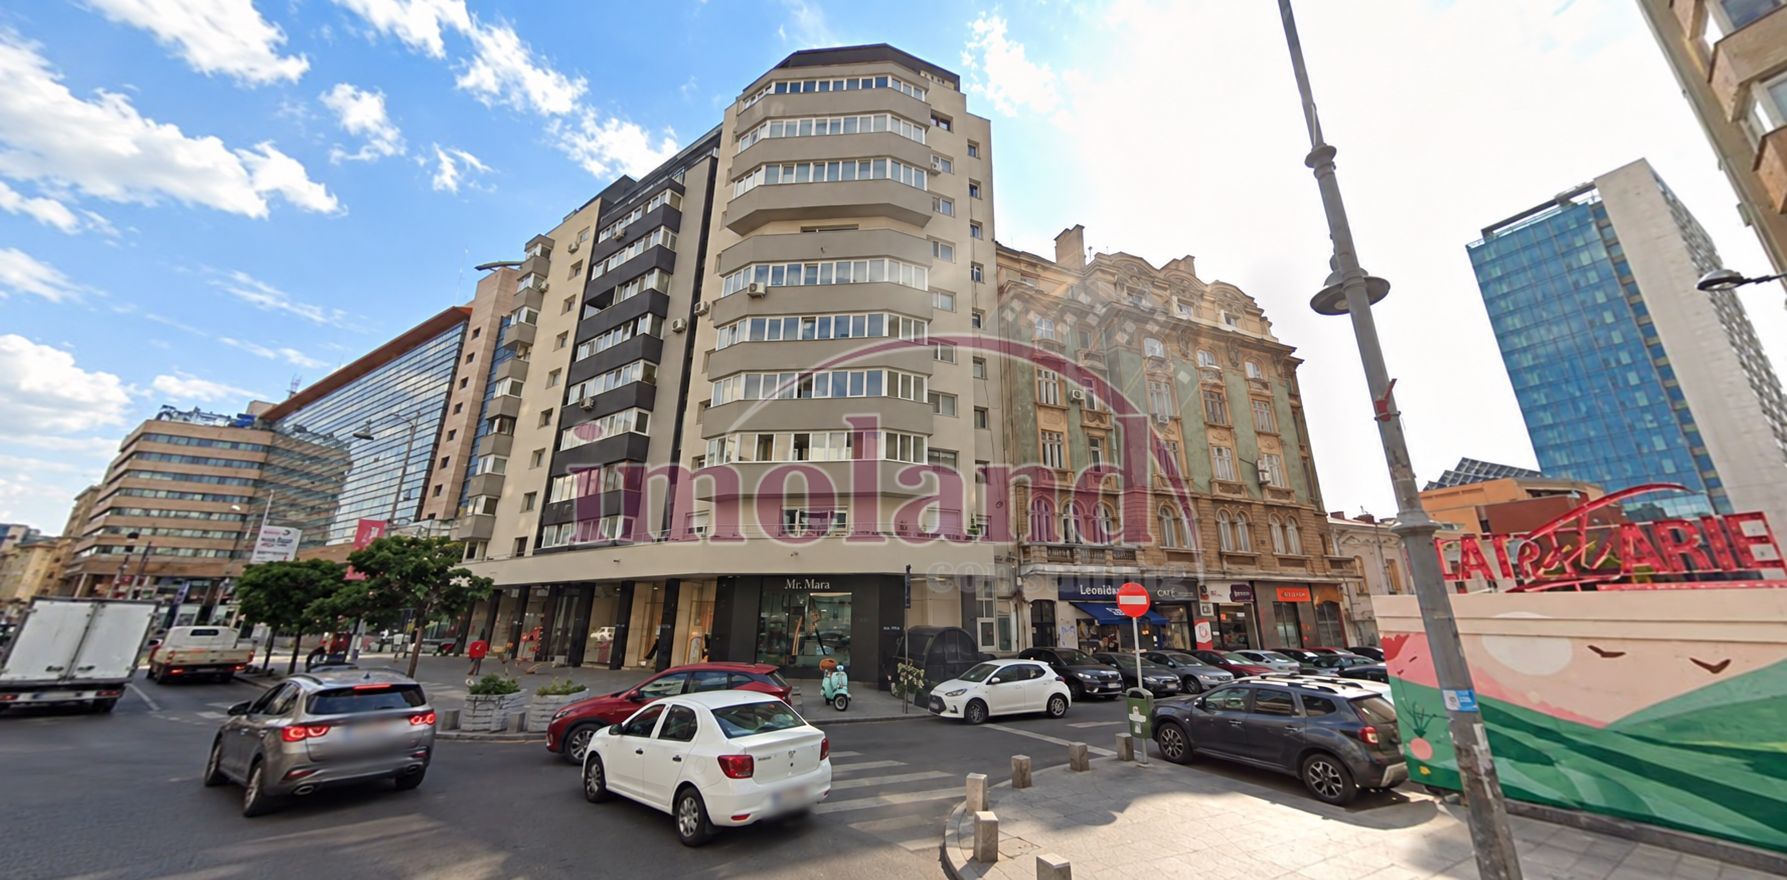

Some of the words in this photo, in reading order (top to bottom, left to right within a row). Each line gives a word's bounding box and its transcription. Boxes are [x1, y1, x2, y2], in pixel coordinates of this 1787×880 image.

[784, 578, 802, 590] Mr.
[804, 578, 831, 590] Mara
[1080, 585, 1119, 596] Leonida
